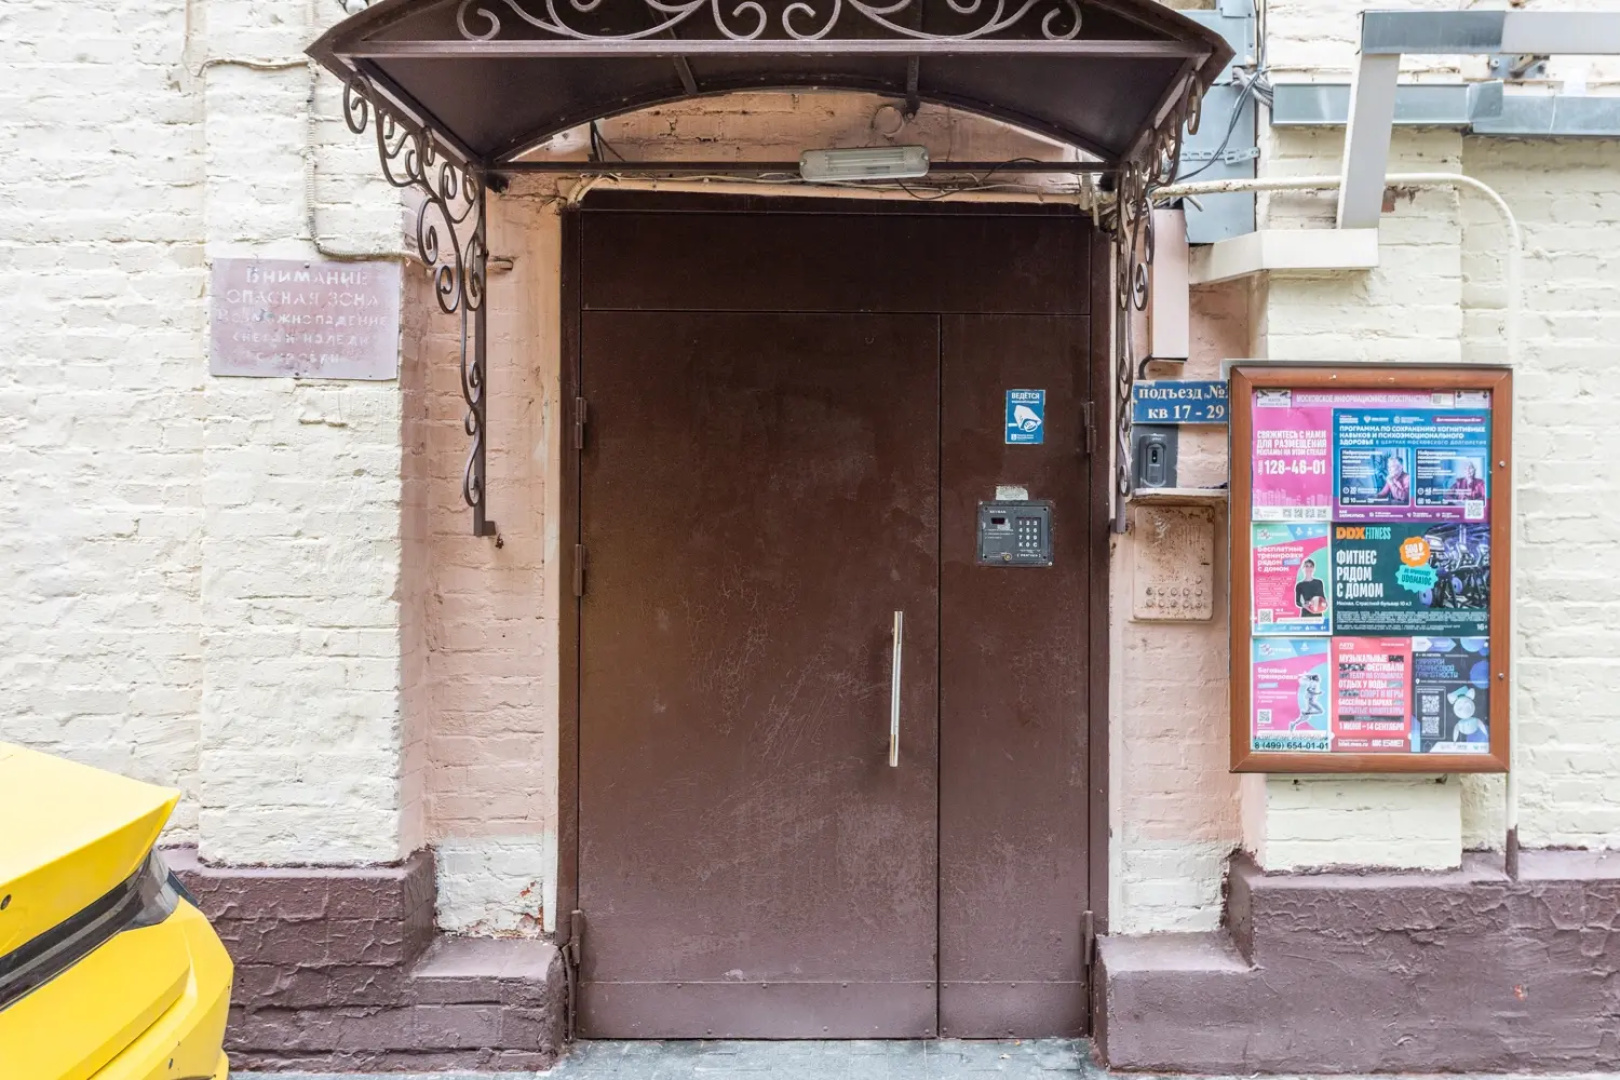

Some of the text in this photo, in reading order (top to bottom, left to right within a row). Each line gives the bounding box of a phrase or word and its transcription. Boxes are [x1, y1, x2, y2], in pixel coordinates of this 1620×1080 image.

[246, 267, 368, 286] ВНИМАНИЕ
[328, 291, 378, 307] ЗОНА
[1139, 388, 1202, 400] подъезд
[1148, 408, 1168, 418] кв
[1173, 405, 1191, 419] 17
[1206, 405, 1225, 419] 29
[1264, 459, 1326, 475] 128-46-01
[1336, 527, 1391, 540] DDX FITNESS
[1336, 550, 1377, 565] ФИТНЕС
[1336, 566, 1372, 582] РЯДОМ
[1336, 583, 1383, 599] С ДОМОМ
[1262, 742, 1284, 750] (499)
[1287, 742, 1329, 750] 654-01-01
